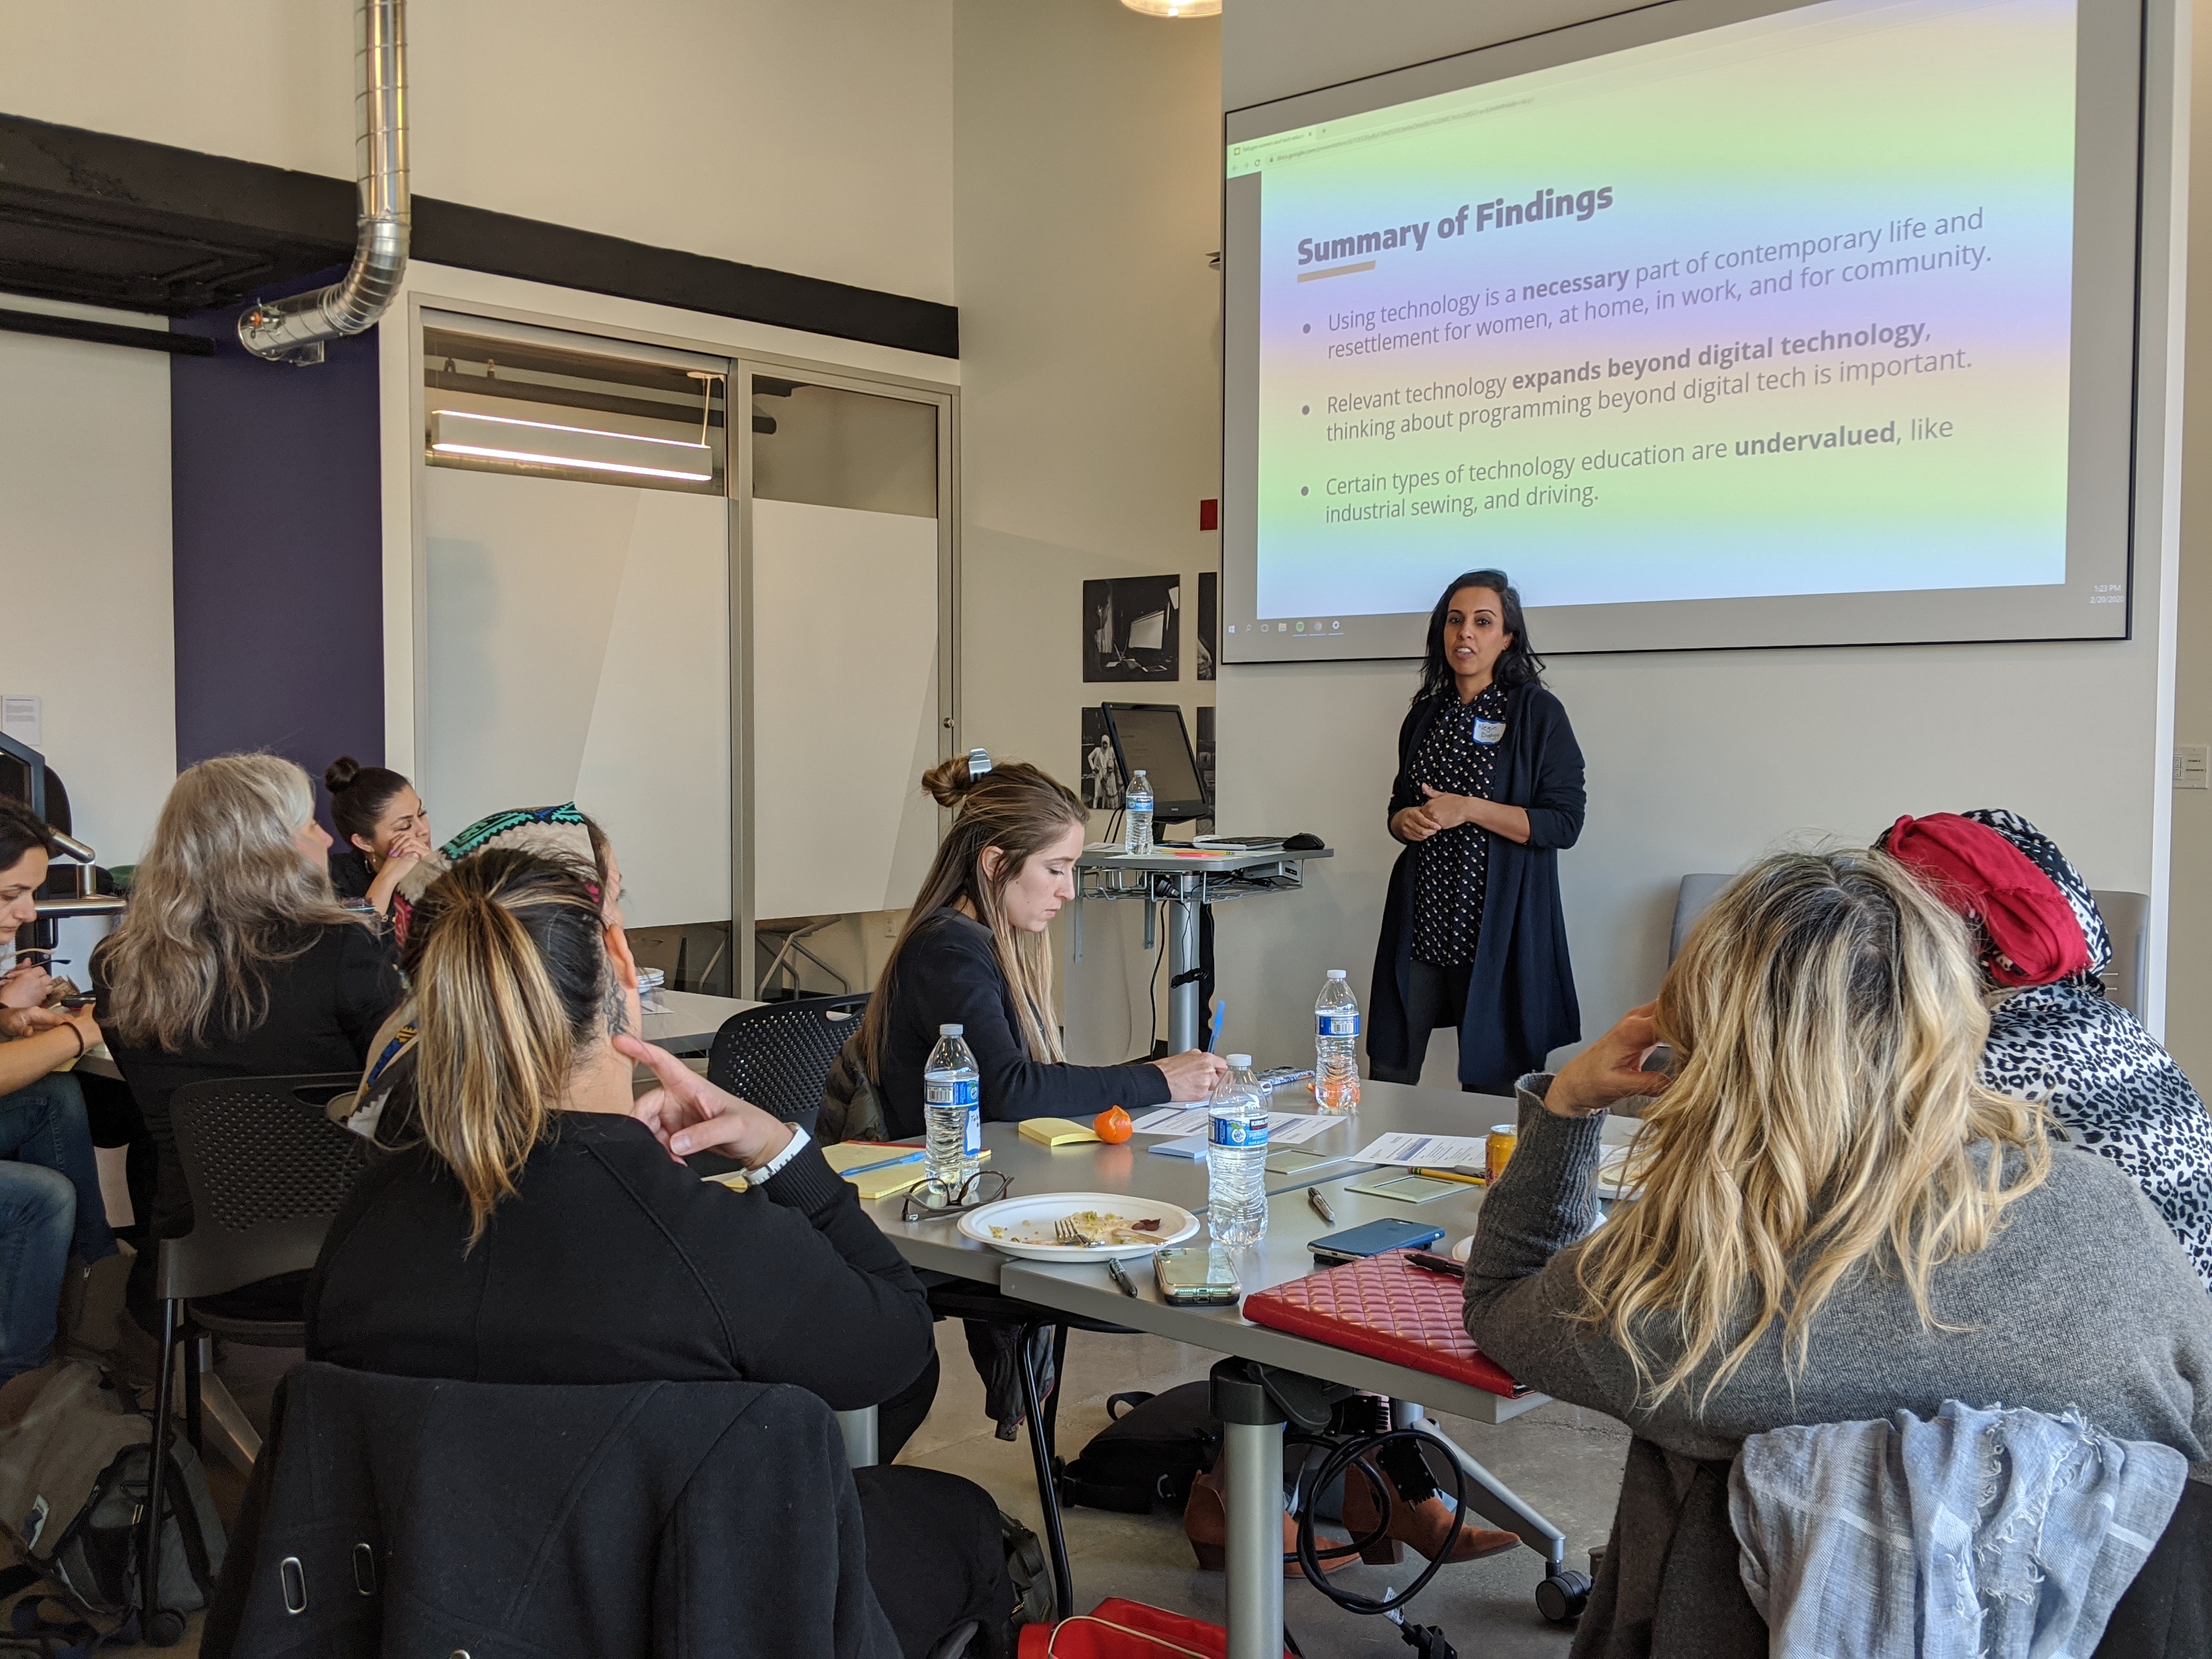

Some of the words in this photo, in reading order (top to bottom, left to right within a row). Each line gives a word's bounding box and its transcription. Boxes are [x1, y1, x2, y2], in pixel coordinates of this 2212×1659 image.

[1298, 221, 1430, 265] Summary
[1437, 204, 1469, 239] of
[1476, 186, 1613, 232] Findings
[1329, 311, 1375, 331] Using
[1381, 294, 1480, 323] technology
[1486, 288, 1499, 306] is
[1505, 289, 1515, 303] a
[1523, 269, 1630, 301] necessary
[1637, 259, 1679, 289] part
[1686, 251, 1709, 274] of
[1715, 228, 1882, 269] contemporary
[1890, 218, 1926, 242] life
[1934, 206, 1983, 235] and
[1329, 326, 1439, 359] resettlement
[1444, 322, 1471, 341] for
[1476, 313, 1552, 336] women,
[1559, 305, 1578, 324] at
[1585, 298, 1649, 320] home,
[1657, 290, 1674, 310] in
[1681, 279, 1741, 306] work,
[1750, 269, 1792, 296] and
[1801, 267, 1835, 289] for
[1842, 245, 1991, 282] community.
[1327, 419, 1395, 442] thinking
[1401, 411, 1453, 433] about
[1459, 395, 1592, 432] programming
[1599, 381, 1675, 413] beyond
[1683, 372, 1749, 404] digital
[1757, 366, 1805, 391] tech
[1815, 364, 1831, 385] is
[1840, 349, 1972, 386] important.
[1328, 389, 1401, 414] Relevant
[1406, 377, 1507, 403] technology
[1513, 361, 1601, 393] expands
[1608, 348, 1690, 381] beyond
[1698, 337, 1773, 370] digital
[1781, 323, 1931, 356] technology,
[1327, 473, 1386, 495] Certain
[1392, 472, 1440, 495] types
[1446, 464, 1465, 484] of
[1469, 456, 1576, 482] technology
[1582, 445, 1684, 471] education
[1692, 443, 1727, 460] are
[1735, 421, 1901, 456] undervalued,
[1911, 417, 1953, 441] like
[1327, 498, 1405, 523] industrial
[1411, 495, 1477, 517] sewing,
[1484, 488, 1519, 509] and
[1526, 484, 1598, 507] driving.
